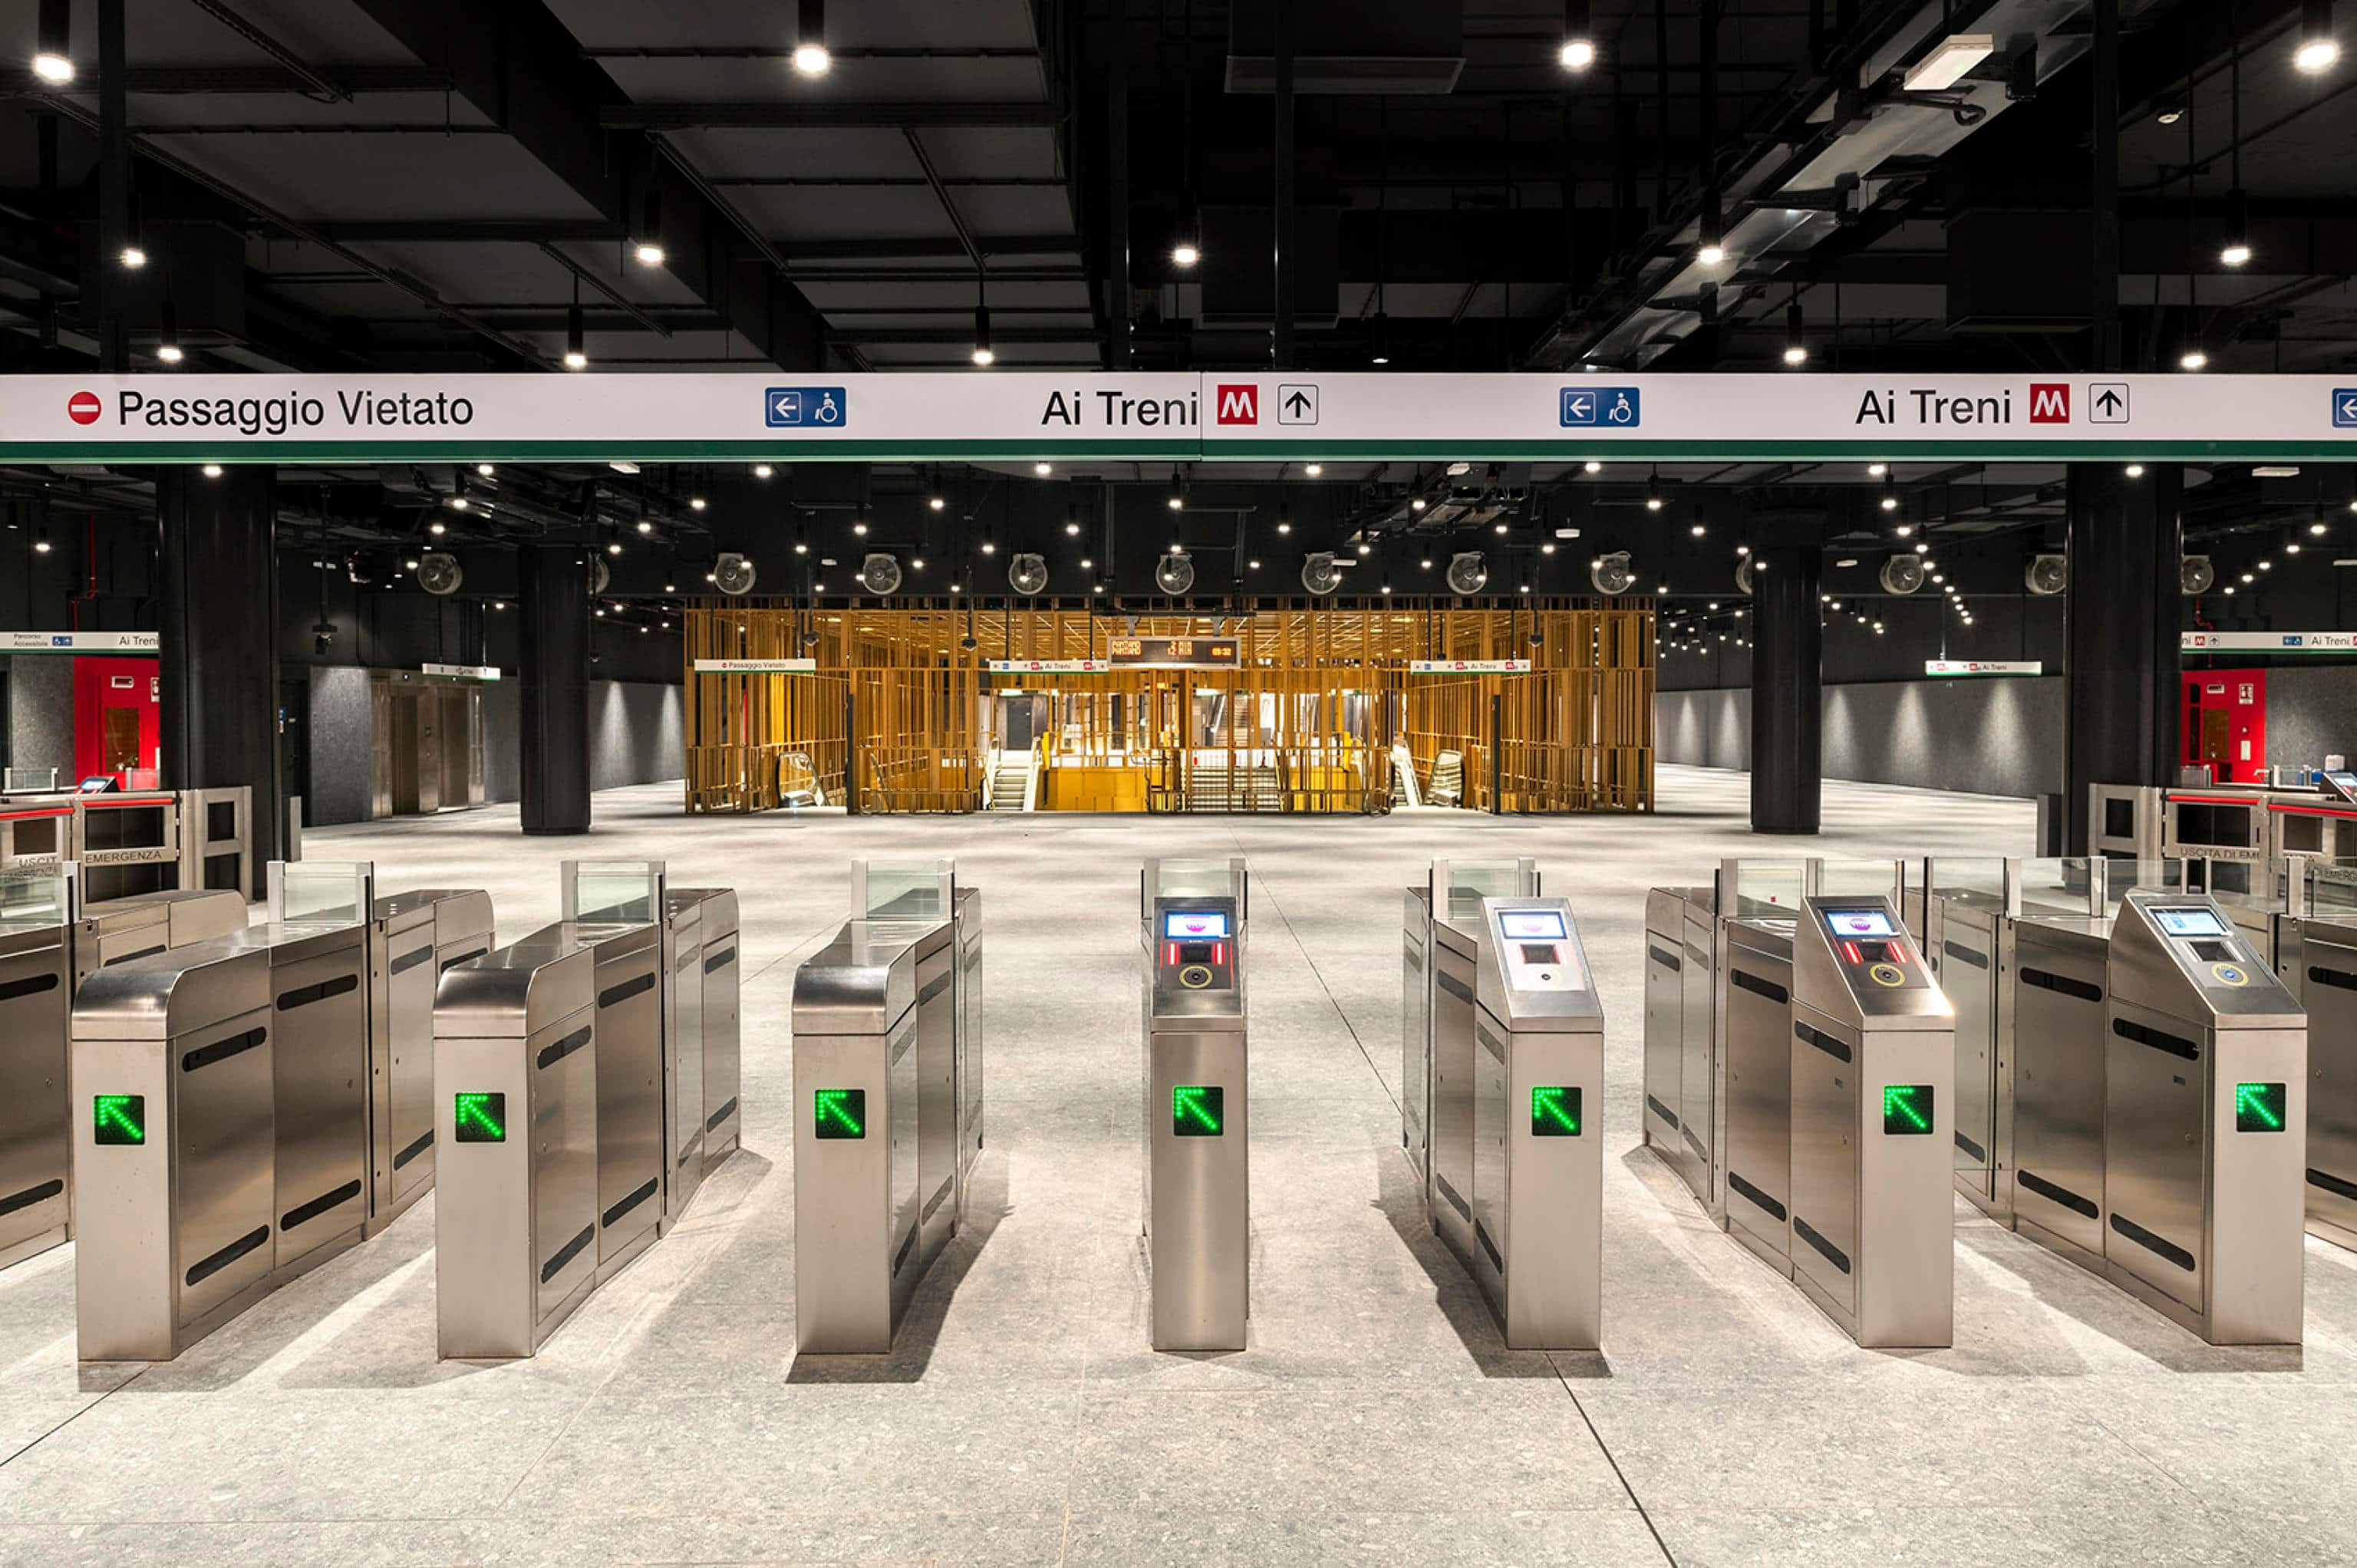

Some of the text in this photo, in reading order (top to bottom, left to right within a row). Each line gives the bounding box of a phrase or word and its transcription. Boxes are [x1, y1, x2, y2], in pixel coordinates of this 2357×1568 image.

[1041, 390, 1256, 426] Ai Treni M
[1855, 387, 2069, 425] Ai Treni M
[118, 390, 474, 436] Passaggio Vietato
[118, 636, 160, 646] Ai Treni
[2310, 636, 2322, 645] Ai
[2325, 636, 2349, 646] Treni
[85, 850, 162, 863] EMERGENZA
[2180, 846, 2222, 859] USCITA
